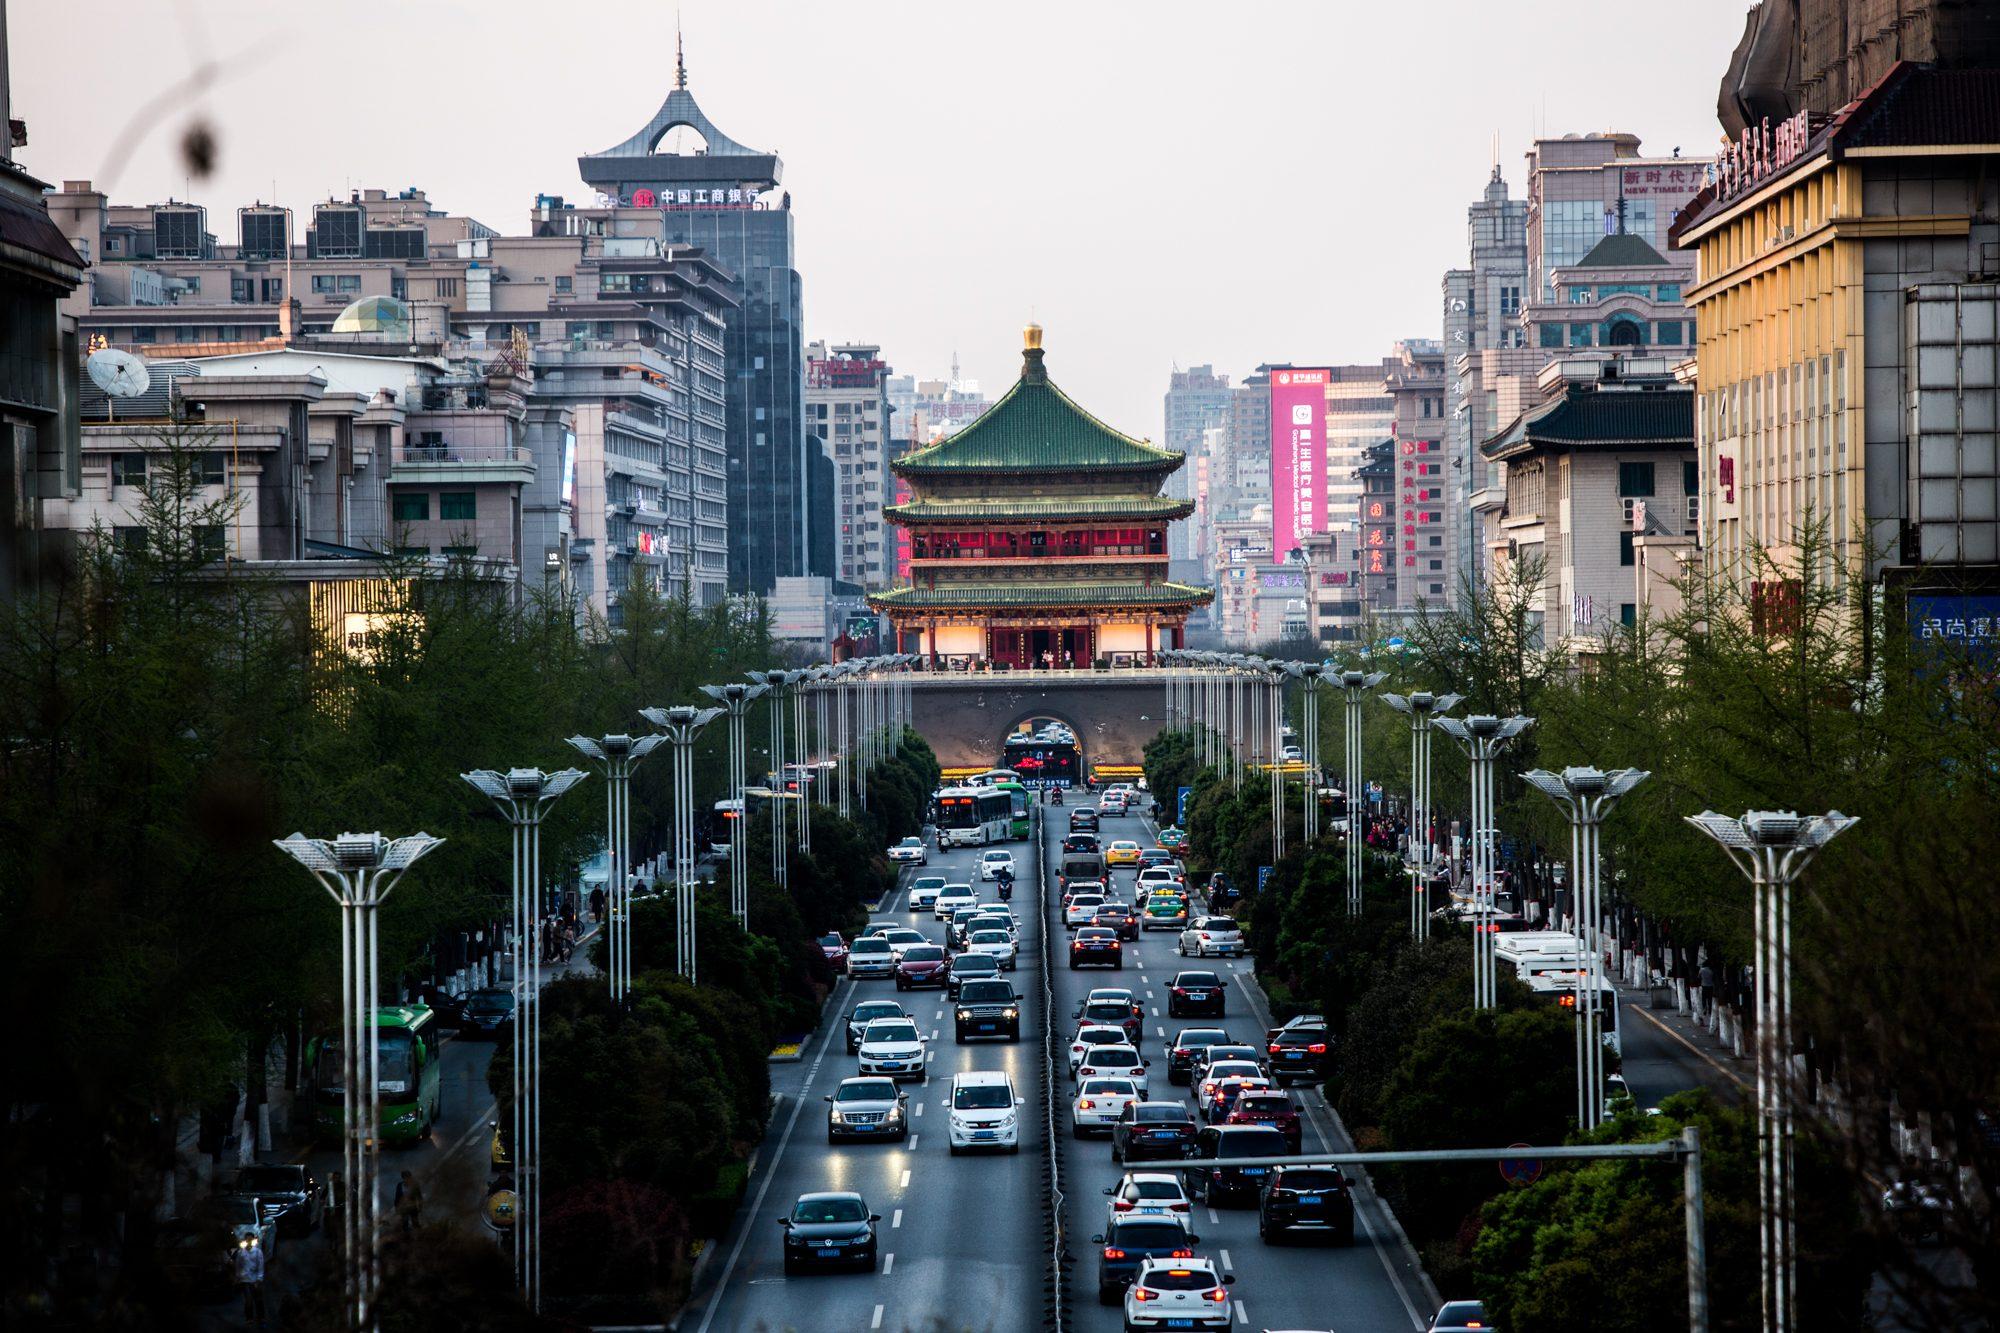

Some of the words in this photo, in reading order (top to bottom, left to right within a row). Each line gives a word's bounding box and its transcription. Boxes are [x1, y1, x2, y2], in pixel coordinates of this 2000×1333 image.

[1624, 186, 1649, 194] NEW
[1652, 185, 1685, 194] TIMES
[1921, 617, 2000, 639] 品尚摄
